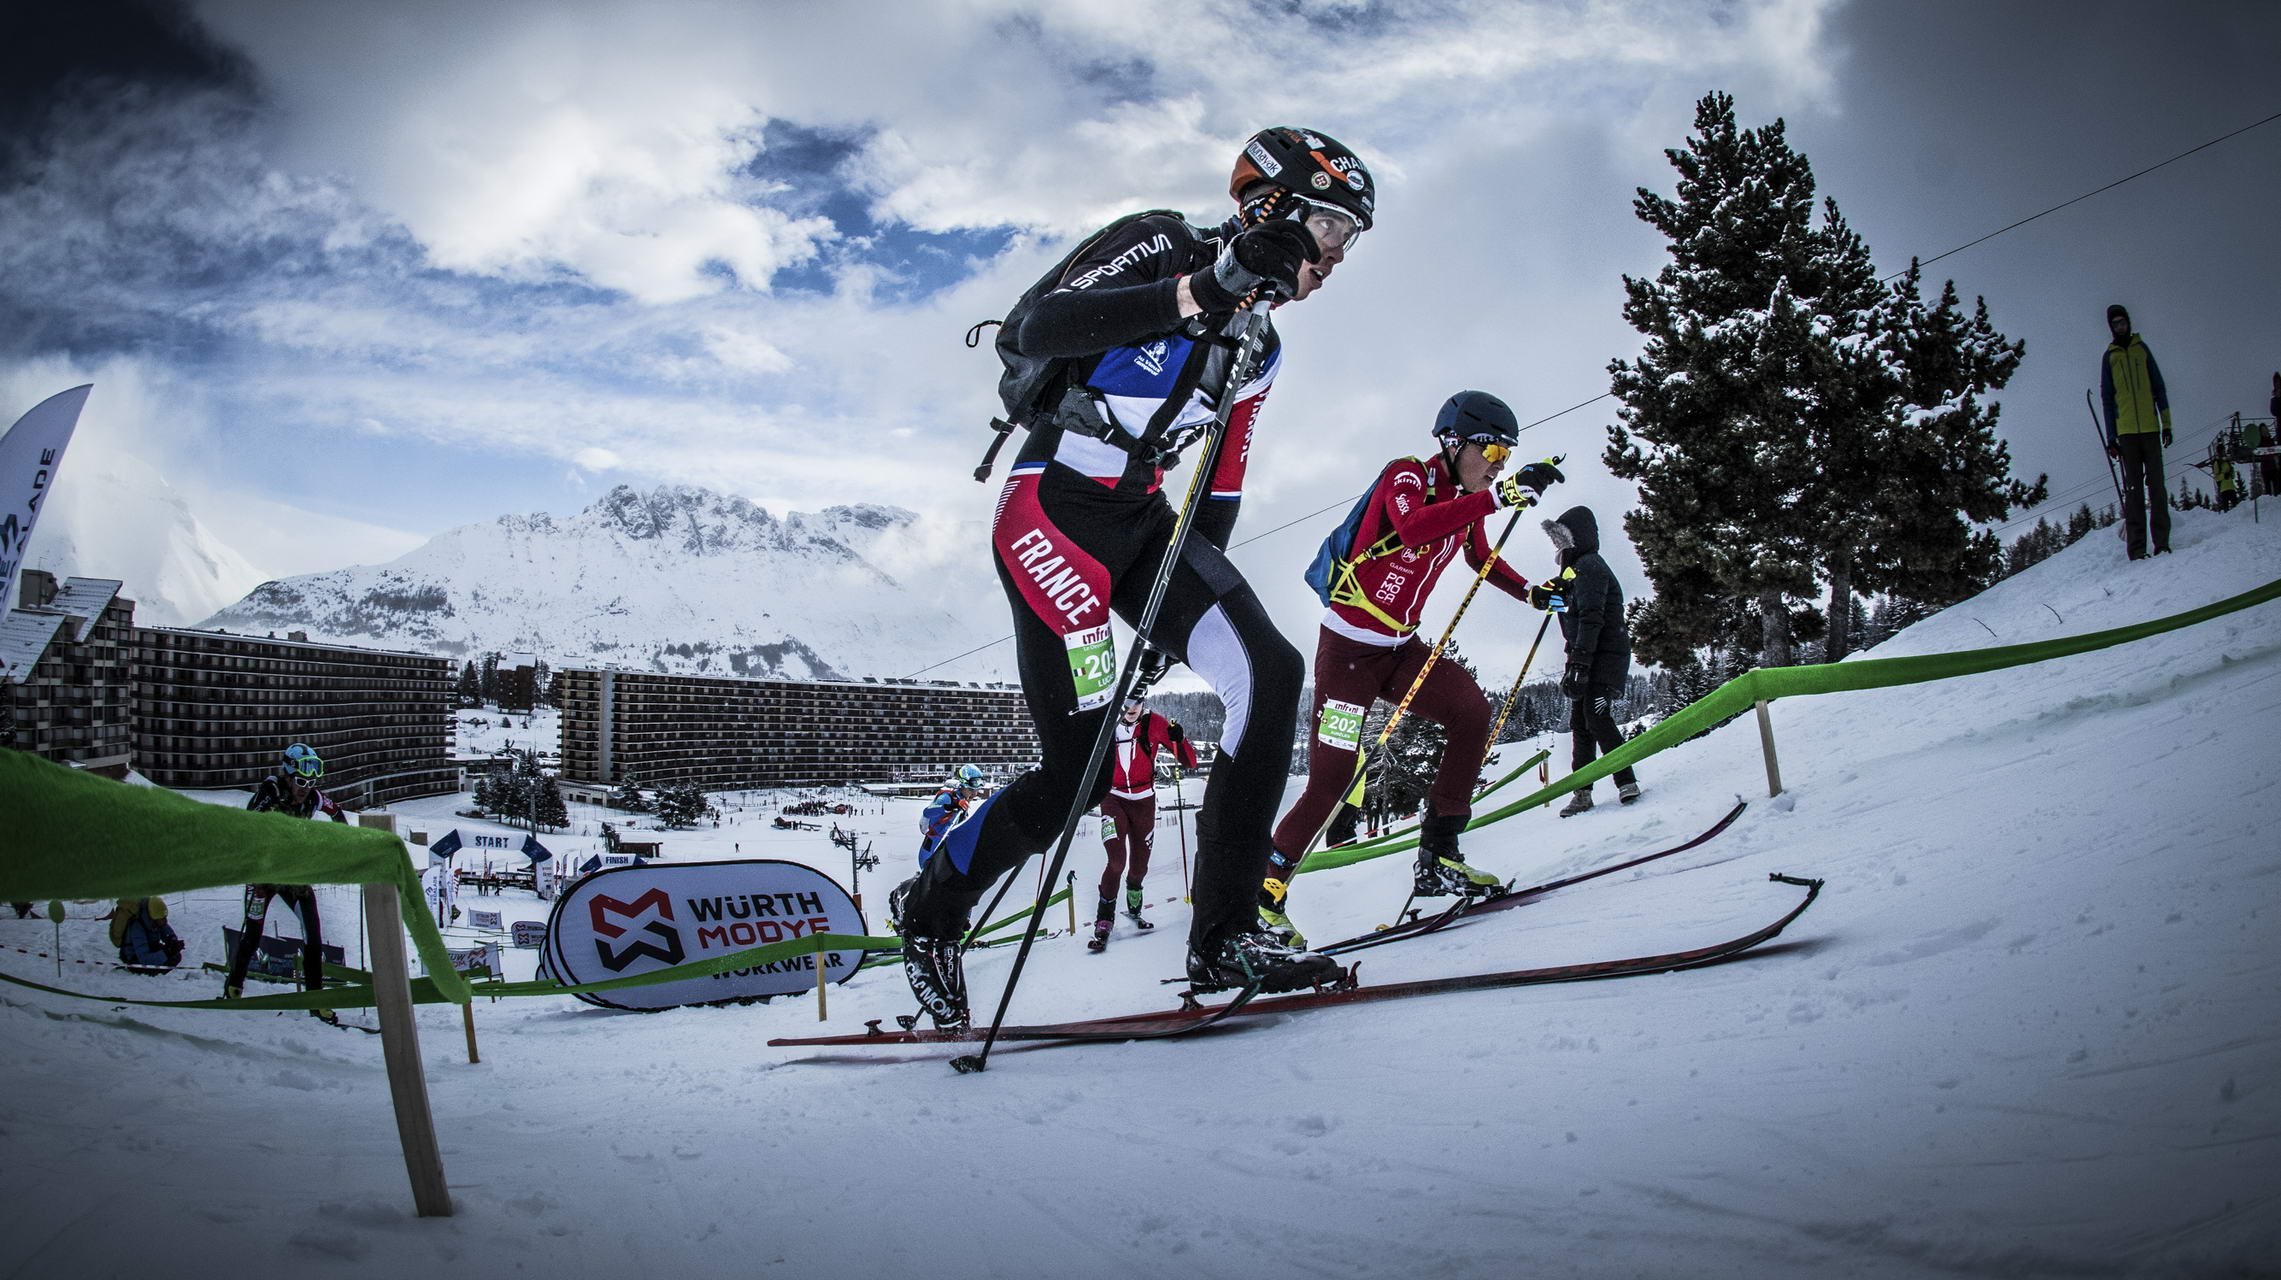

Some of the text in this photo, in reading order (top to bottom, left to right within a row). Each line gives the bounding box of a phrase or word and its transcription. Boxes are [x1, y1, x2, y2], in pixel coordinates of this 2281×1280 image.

[1070, 233, 1173, 290] SPORTIVA
[1504, 478, 1529, 503] EKI
[1011, 528, 1101, 626] FRANCE
[1389, 562, 1415, 575] GARMIN
[1328, 715, 1357, 734] 202
[475, 835, 510, 848] START
[605, 856, 629, 864] FINISH
